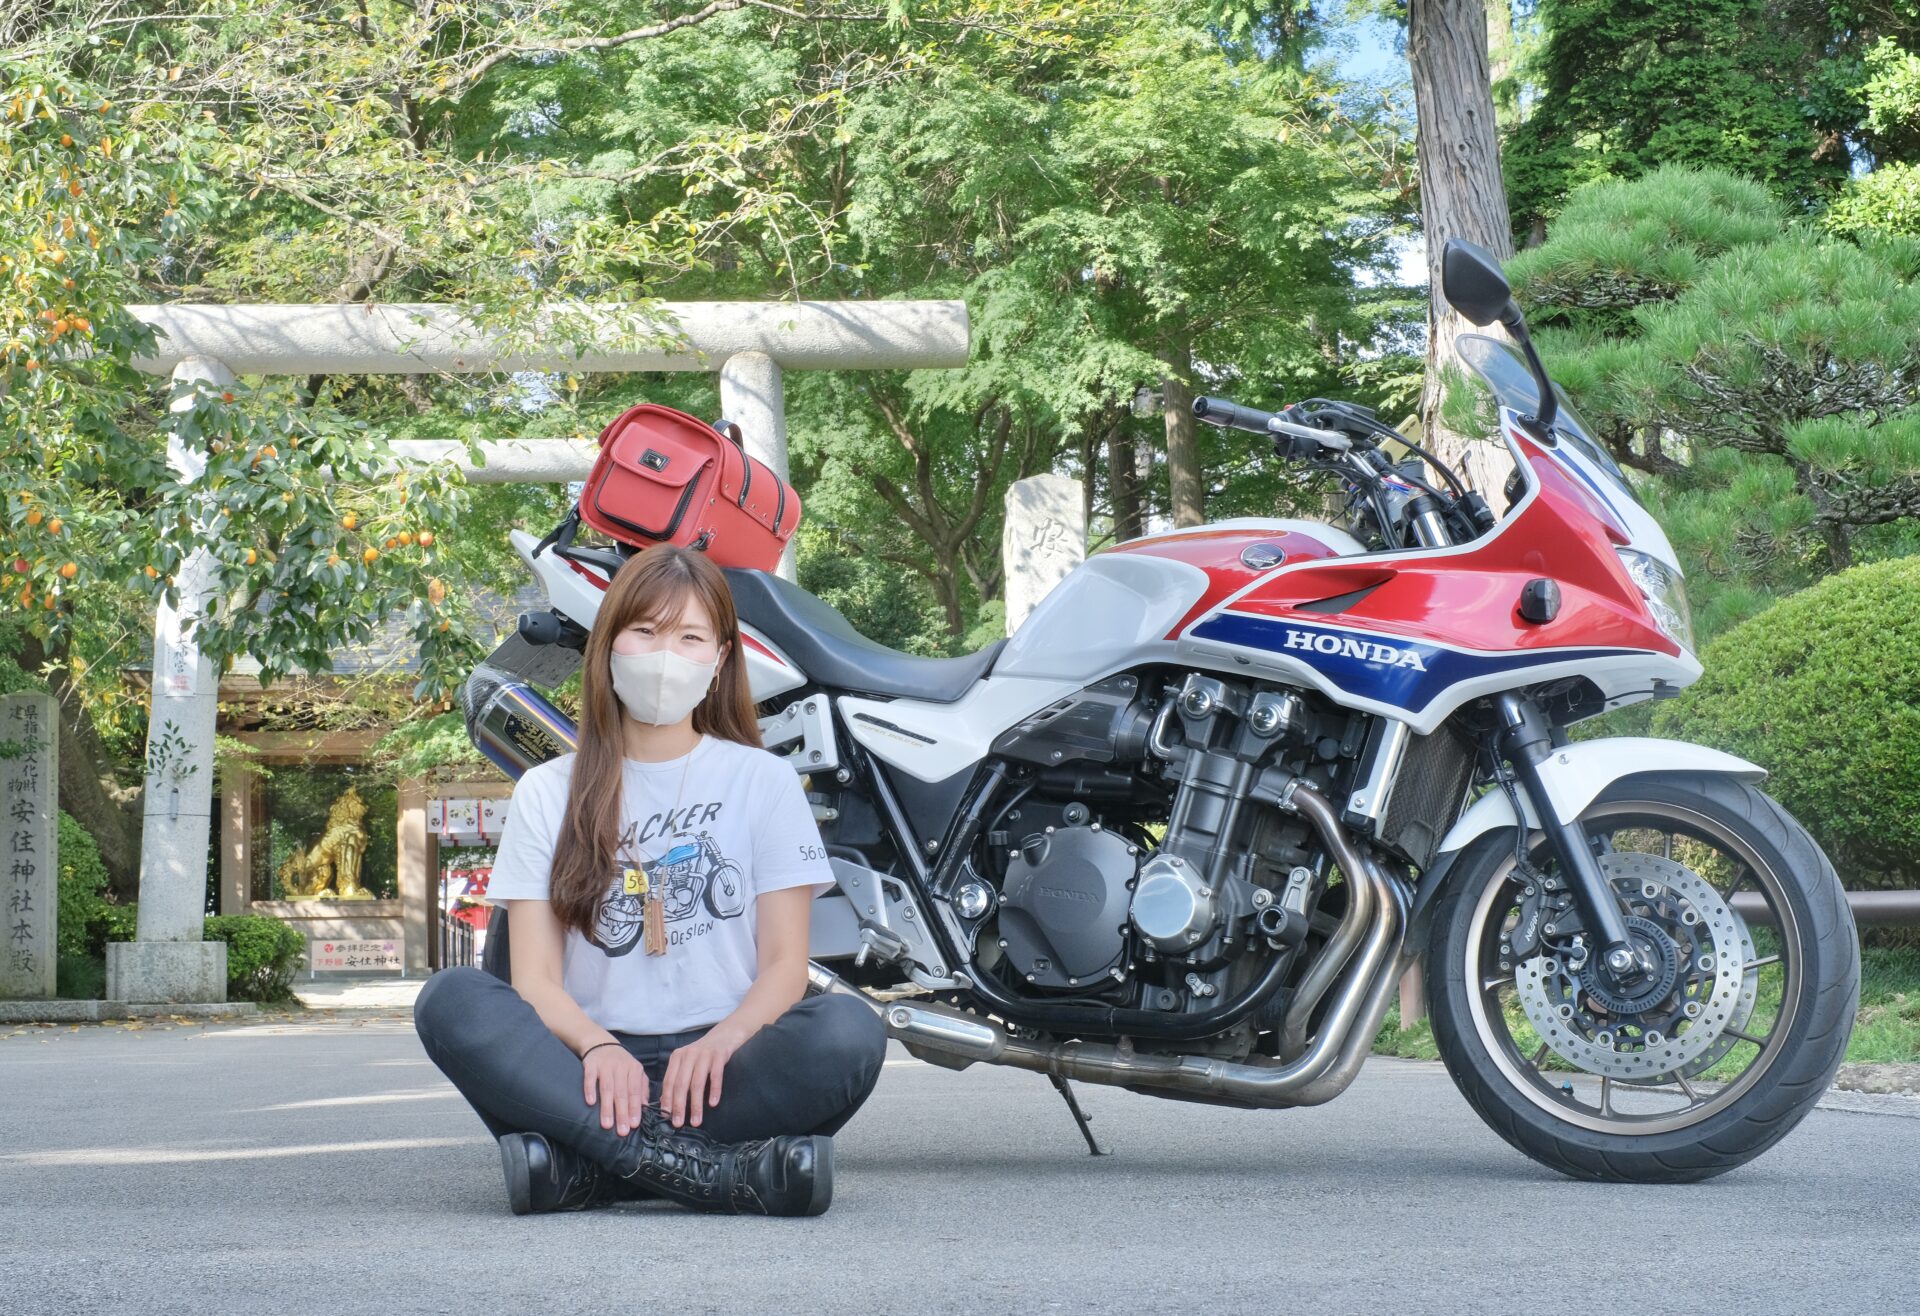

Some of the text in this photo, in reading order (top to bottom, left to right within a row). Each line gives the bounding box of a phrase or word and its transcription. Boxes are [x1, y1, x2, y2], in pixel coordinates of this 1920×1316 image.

[1284, 630, 1427, 672] HONDA
[616, 802, 723, 850] ACKER
[9, 799, 36, 973] 安住神社本殿
